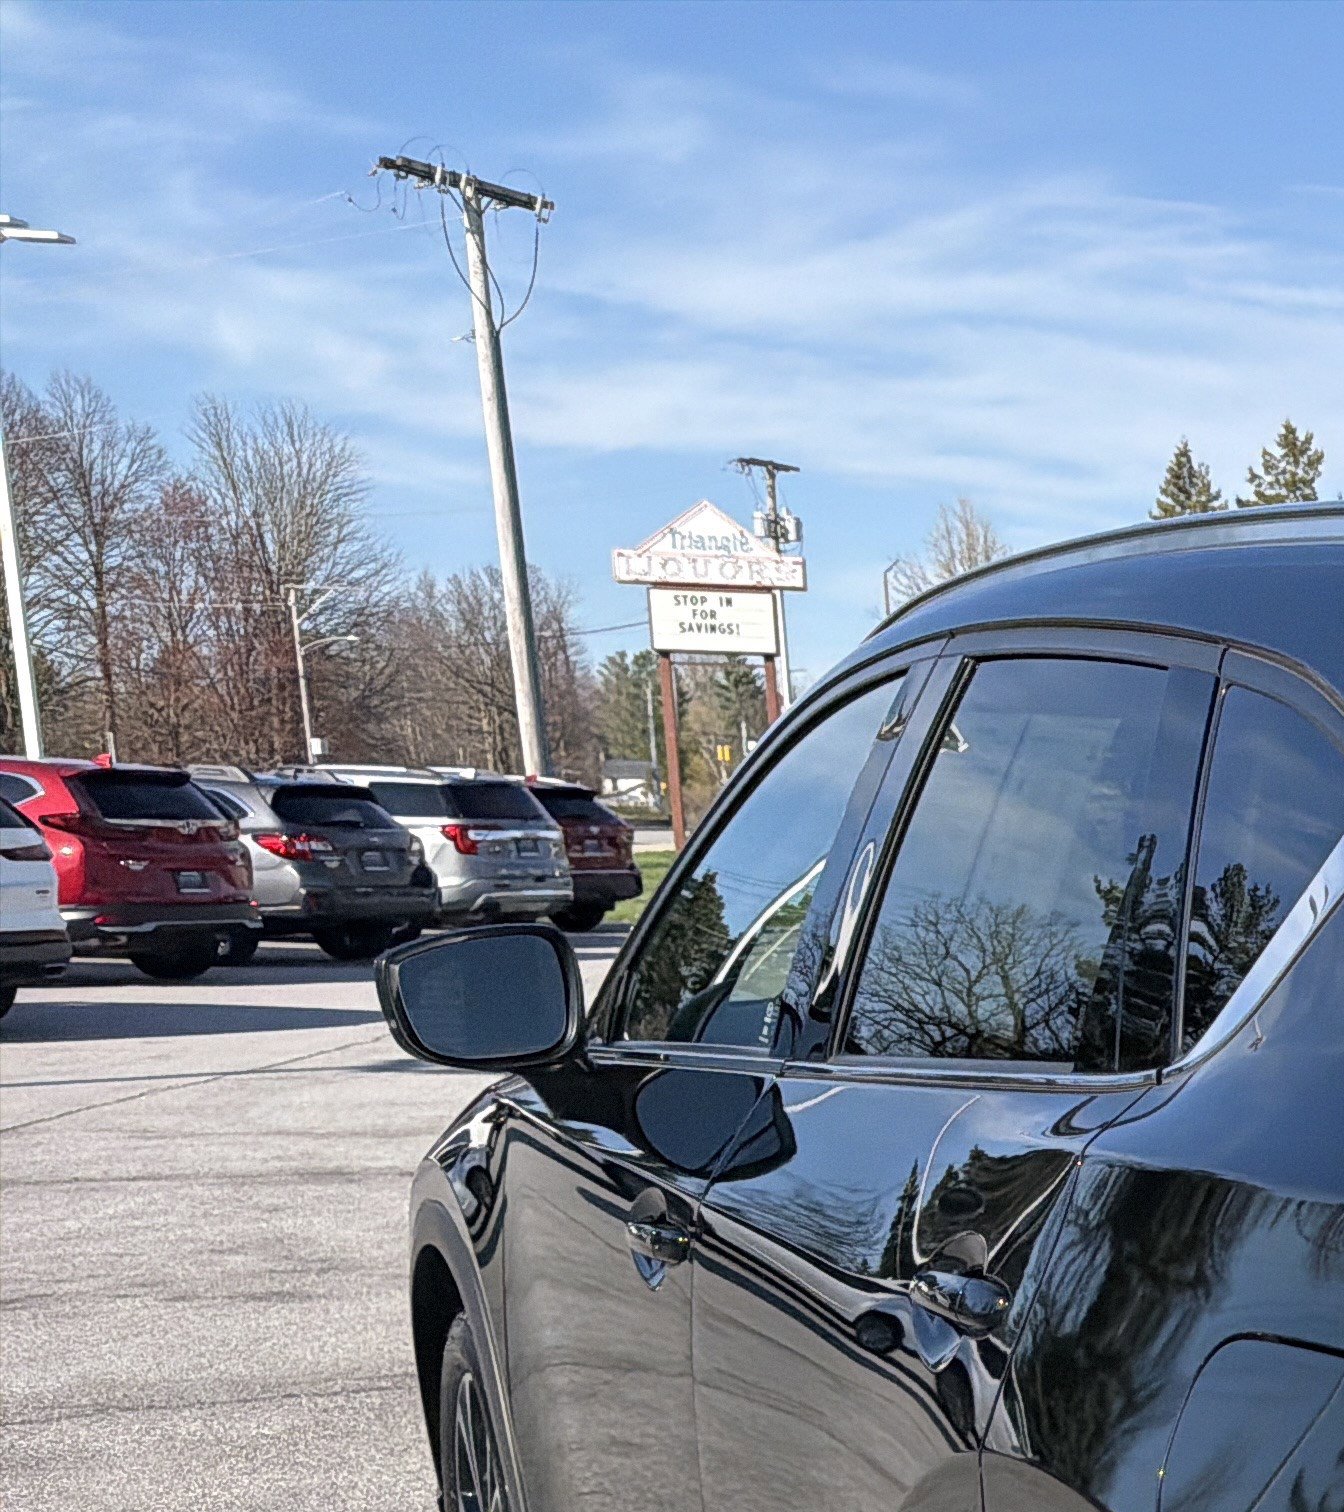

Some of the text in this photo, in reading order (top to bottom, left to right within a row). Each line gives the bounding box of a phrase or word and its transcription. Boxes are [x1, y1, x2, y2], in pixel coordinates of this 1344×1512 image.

[670, 528, 754, 558] Triangle
[673, 594, 734, 607] STOP IN
[692, 609, 718, 620] FOR
[679, 621, 741, 636] SAVINGS!
